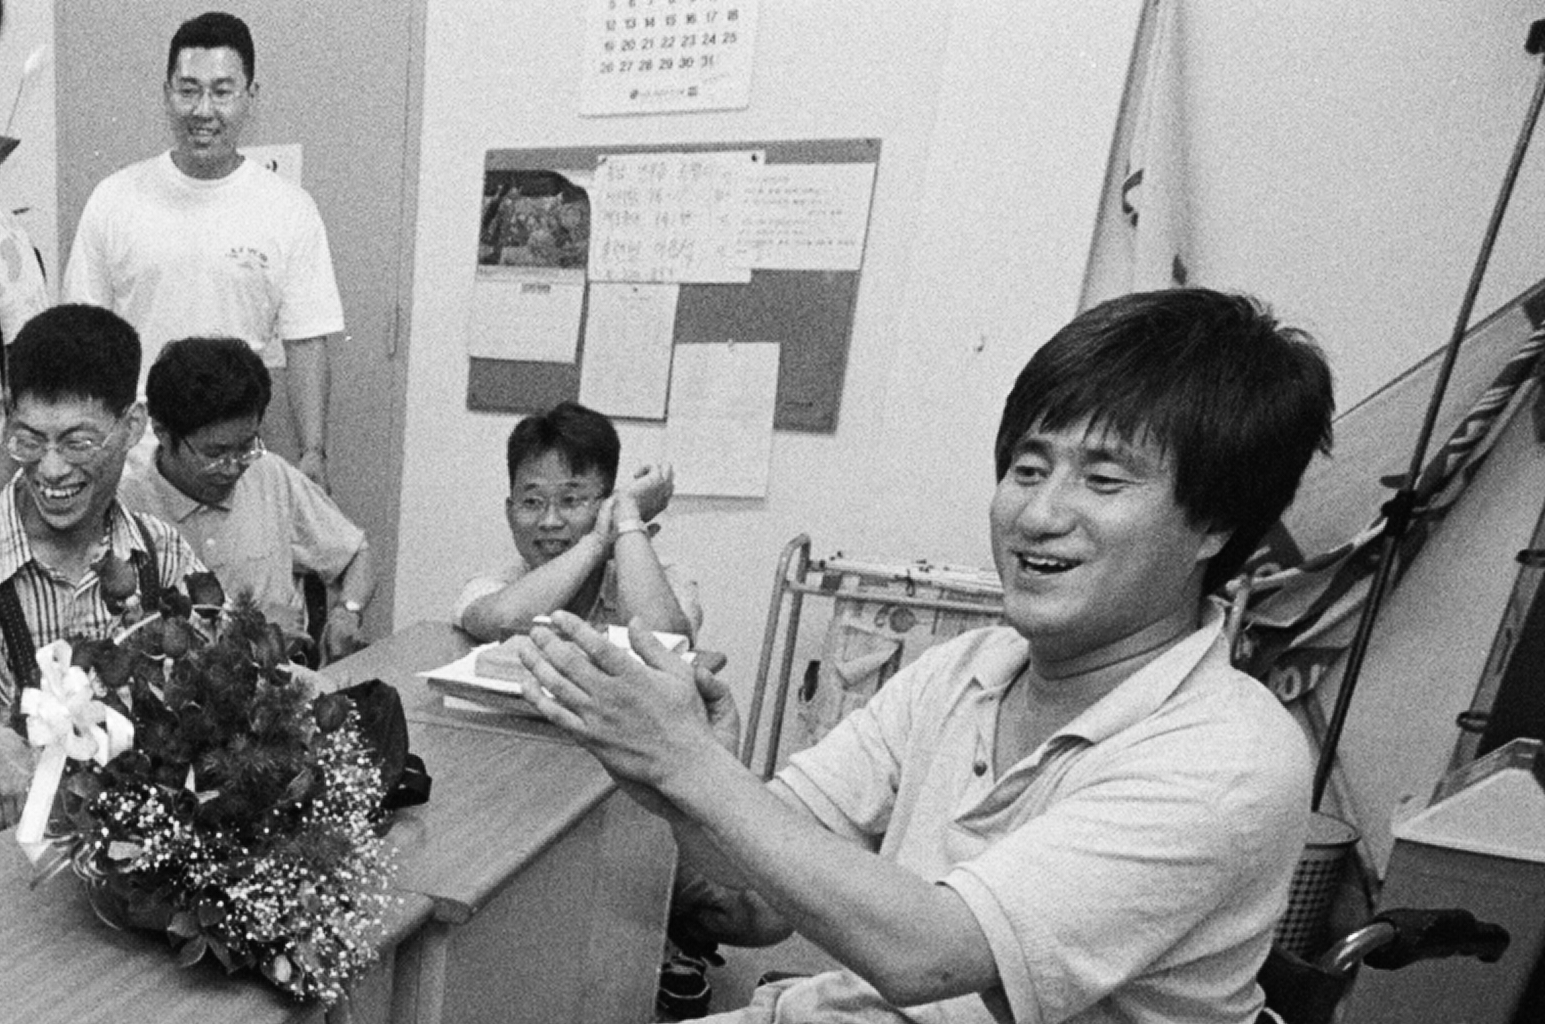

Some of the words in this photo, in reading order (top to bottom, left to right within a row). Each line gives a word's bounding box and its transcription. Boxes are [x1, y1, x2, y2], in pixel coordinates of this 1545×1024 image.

[706, 10, 718, 23] 17
[621, 38, 636, 52] 20
[641, 37, 654, 50] 21
[660, 36, 675, 49] 22
[680, 34, 696, 48] 23
[702, 33, 716, 46] 24
[722, 31, 737, 44] 25
[600, 61, 614, 74] 26
[619, 60, 634, 73] 27
[638, 59, 653, 72] 28
[658, 58, 674, 71] 29
[678, 56, 694, 69] 30
[701, 55, 714, 68] 31
